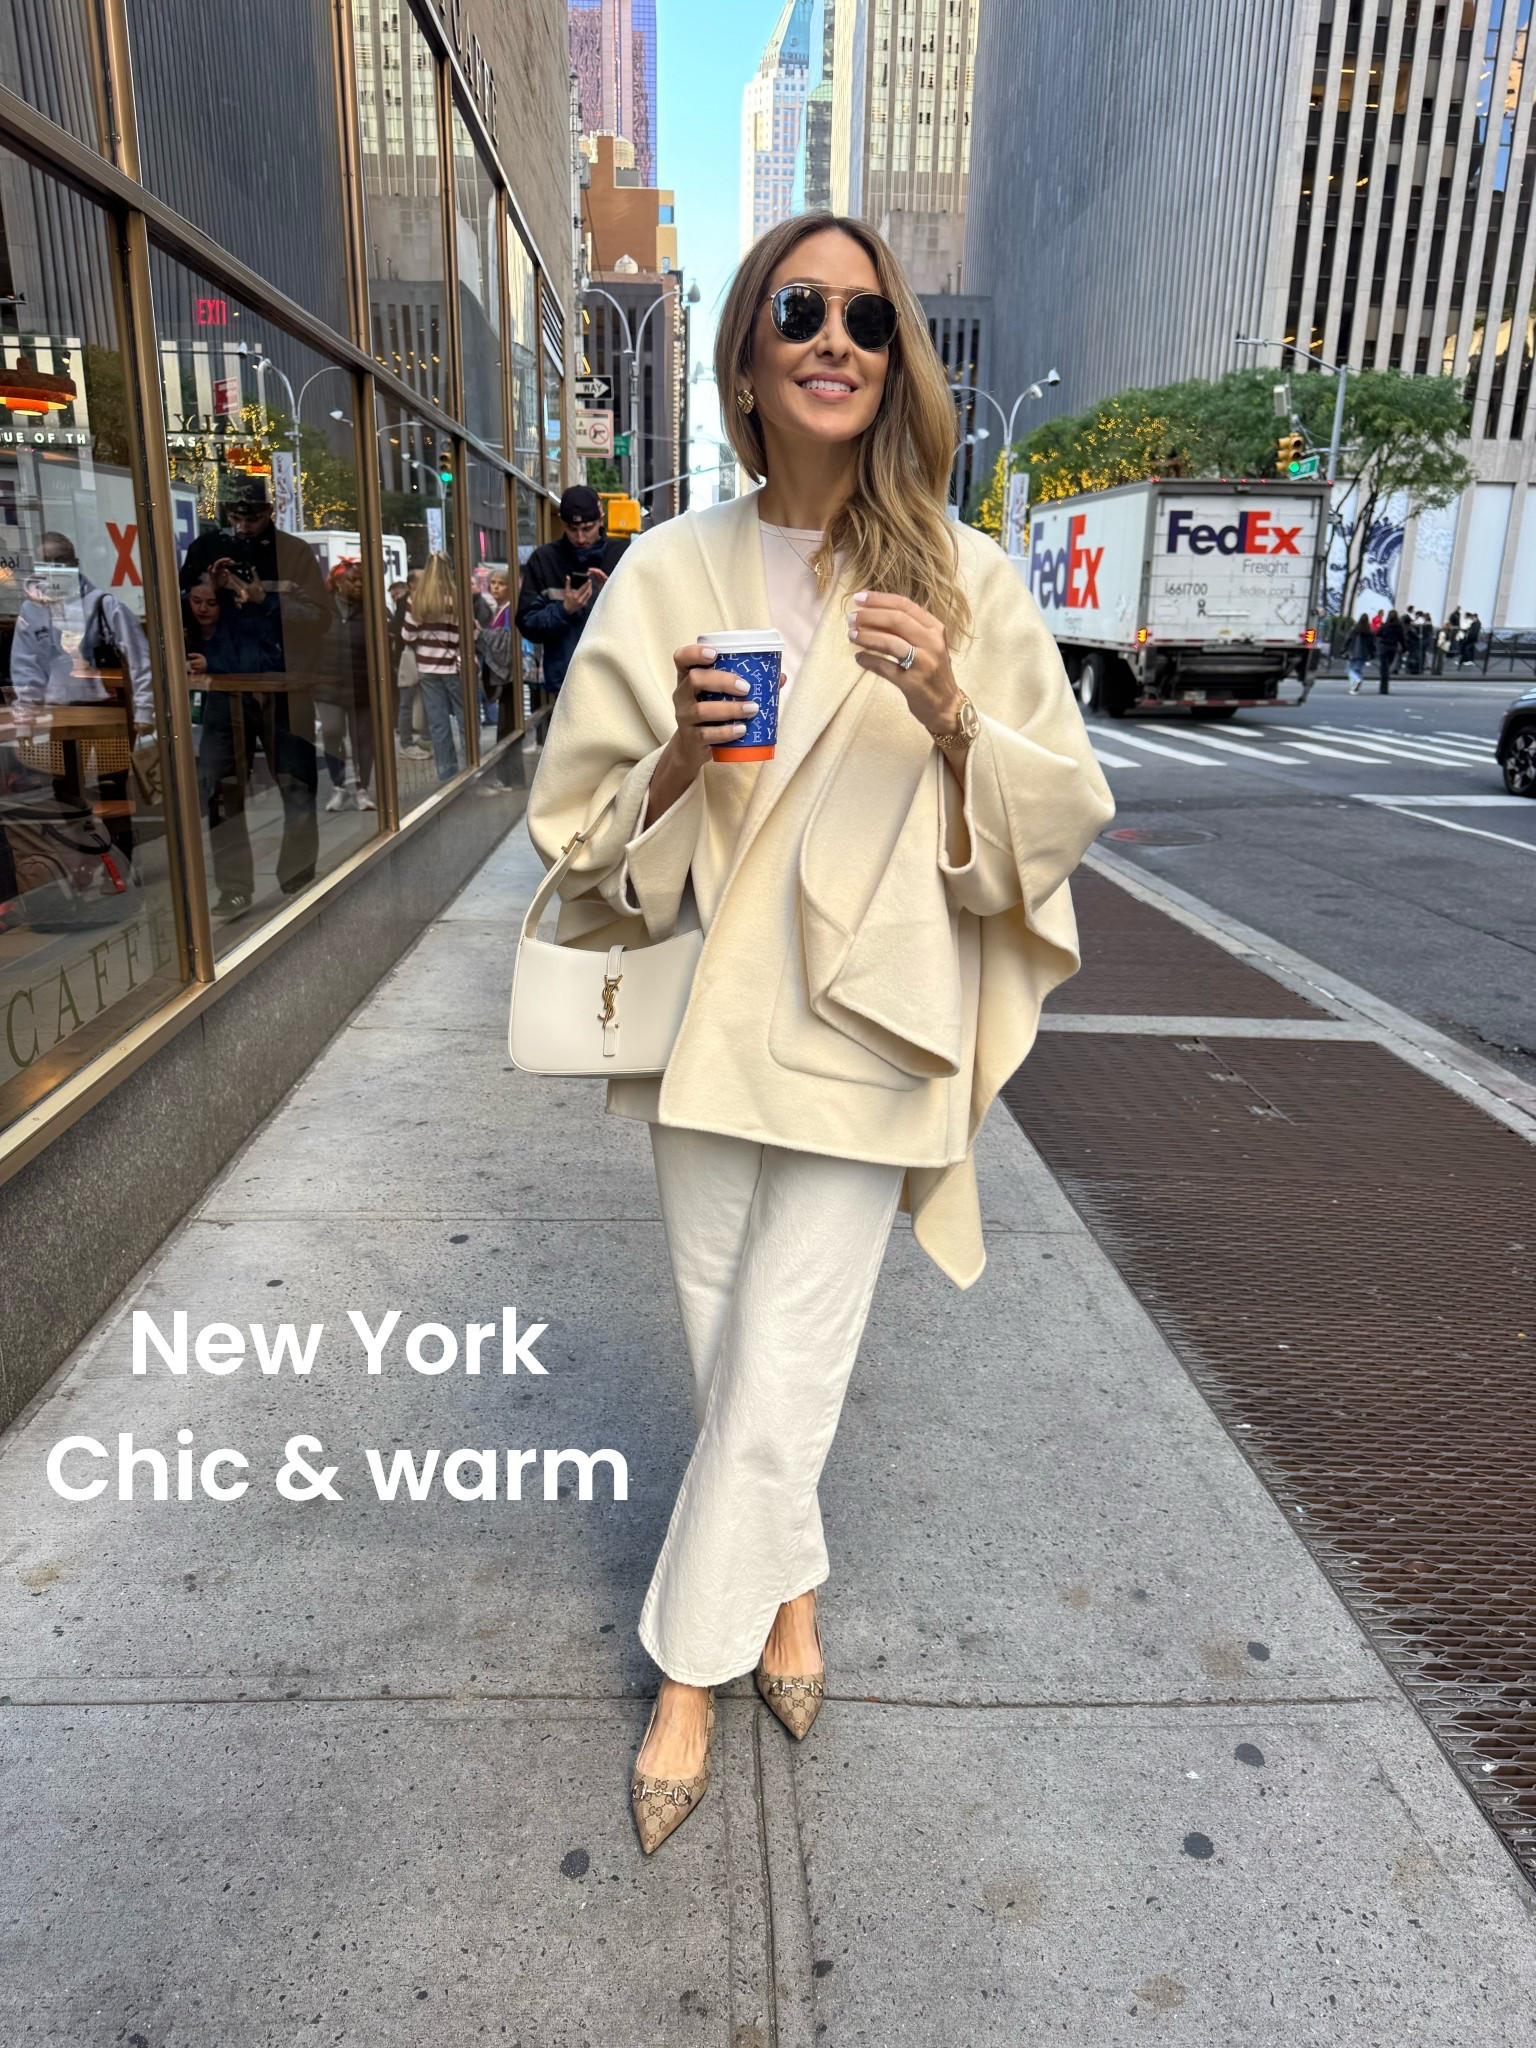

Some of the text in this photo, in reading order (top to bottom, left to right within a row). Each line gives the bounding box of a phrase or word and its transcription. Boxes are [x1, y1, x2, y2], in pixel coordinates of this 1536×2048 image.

[583, 384, 602, 393] WAY
[34, 432, 55, 444] OF
[1166, 510, 1303, 556] FedEx
[1030, 513, 1105, 610] FedEx
[1241, 558, 1289, 577] Freight
